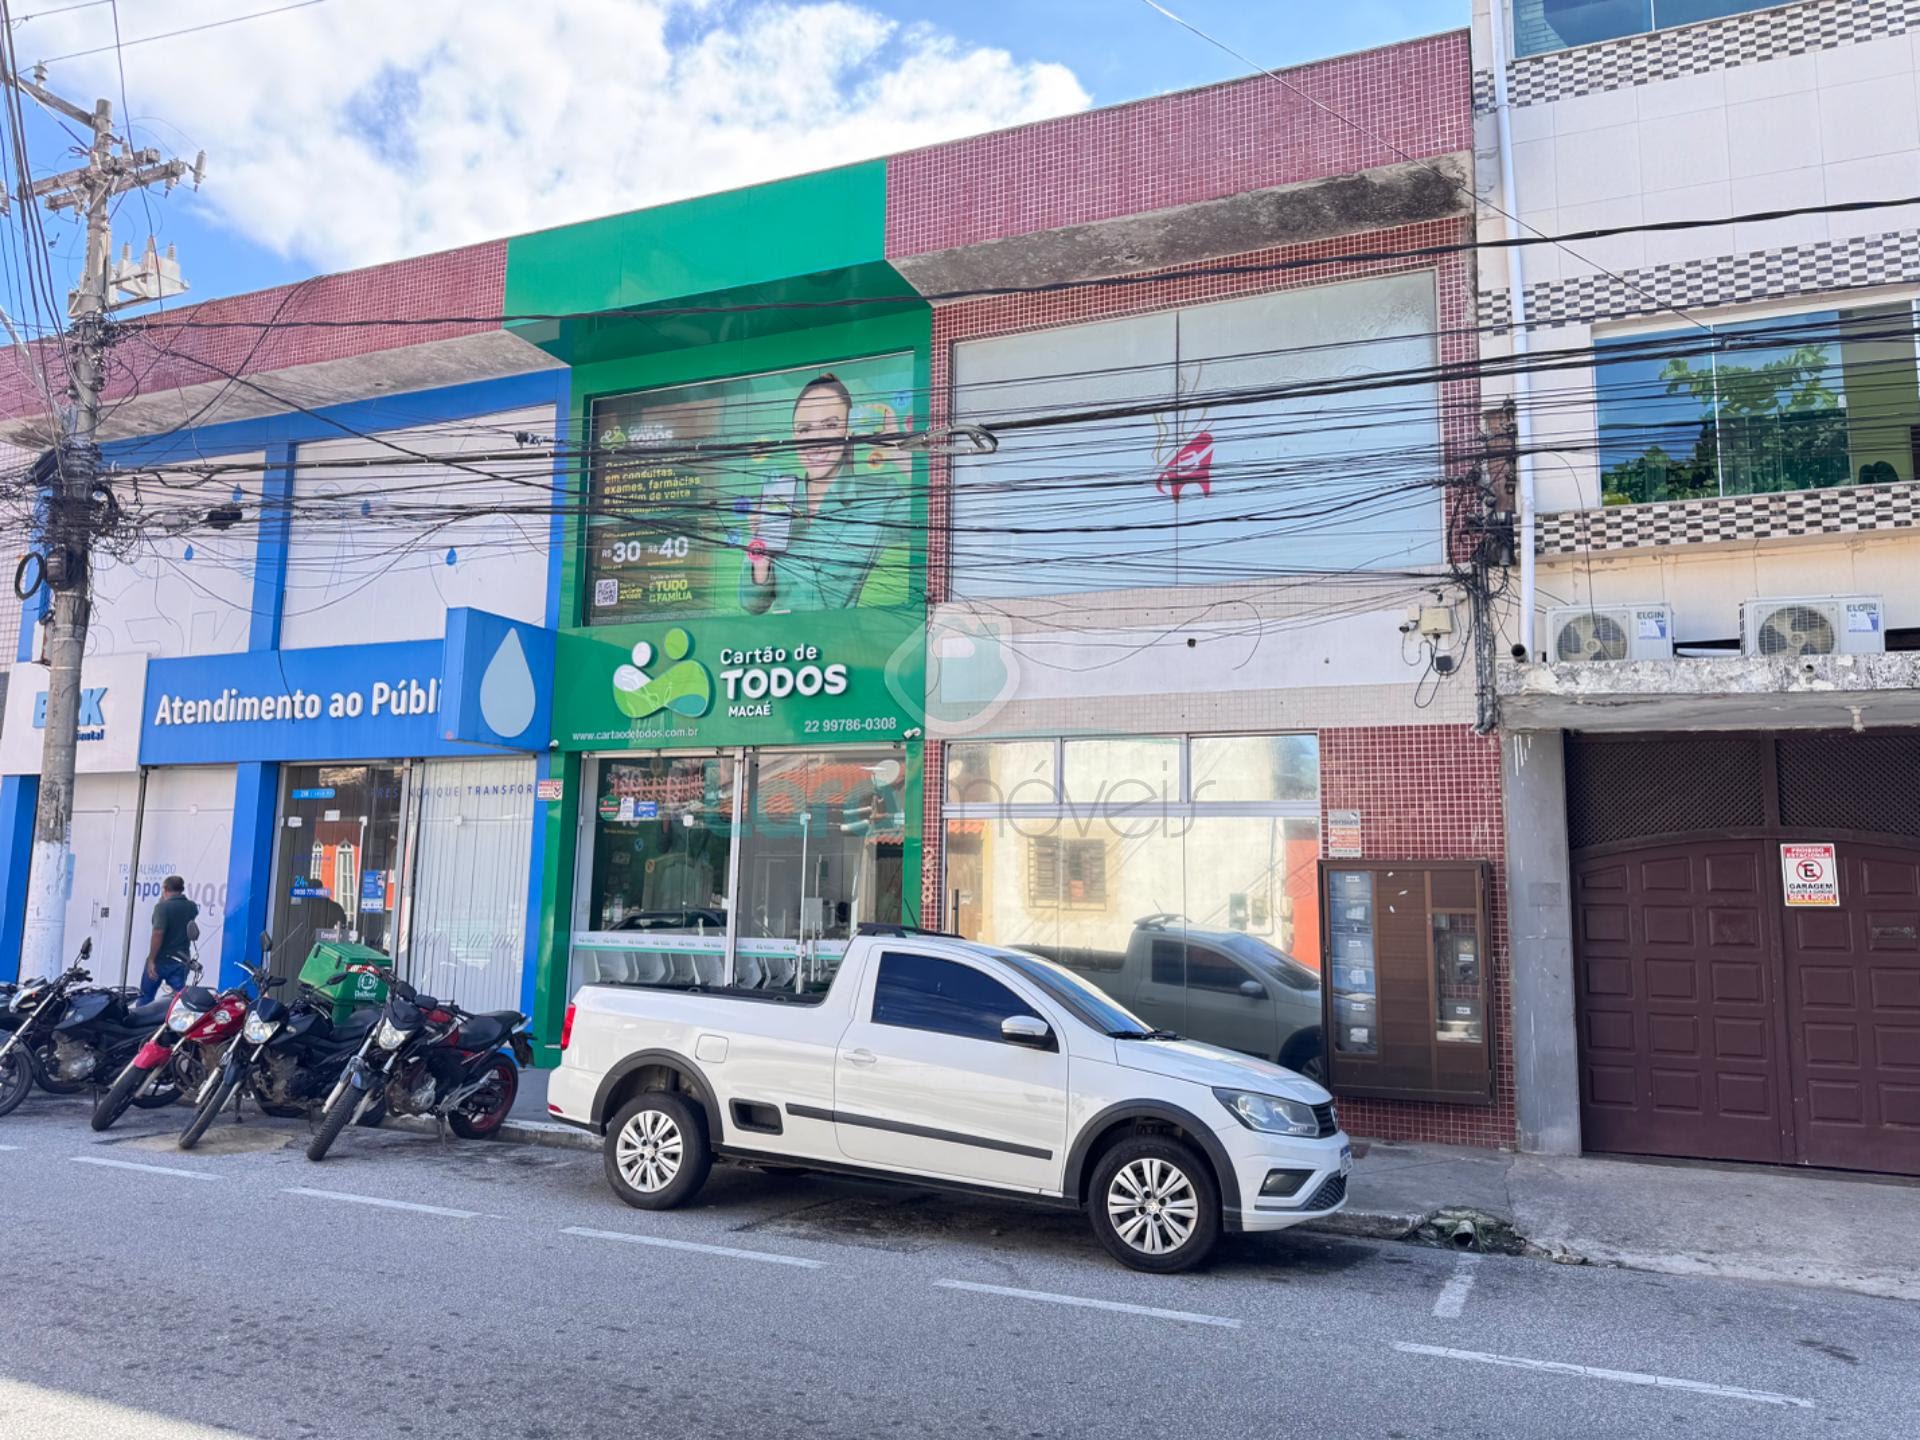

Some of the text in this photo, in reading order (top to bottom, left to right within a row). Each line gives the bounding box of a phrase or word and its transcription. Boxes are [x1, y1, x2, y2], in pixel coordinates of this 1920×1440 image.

[612, 541, 641, 562] 30
[658, 536, 688, 558] 40
[655, 579, 688, 592] TUDO
[1636, 611, 1664, 620] ELGIN
[720, 643, 817, 664] Cartão de
[720, 663, 848, 700] TODOS
[32, 687, 109, 729] BK
[154, 688, 321, 726] Atendimento
[328, 691, 364, 719] ao
[728, 701, 772, 718] MACAÉ
[804, 717, 897, 733] 22 99786-0308
[572, 728, 699, 741] www.cartaodetodos.com.br
[436, 786, 460, 798] QUE
[467, 783, 534, 798] TRANSFOR
[1804, 863, 1815, 878] E
